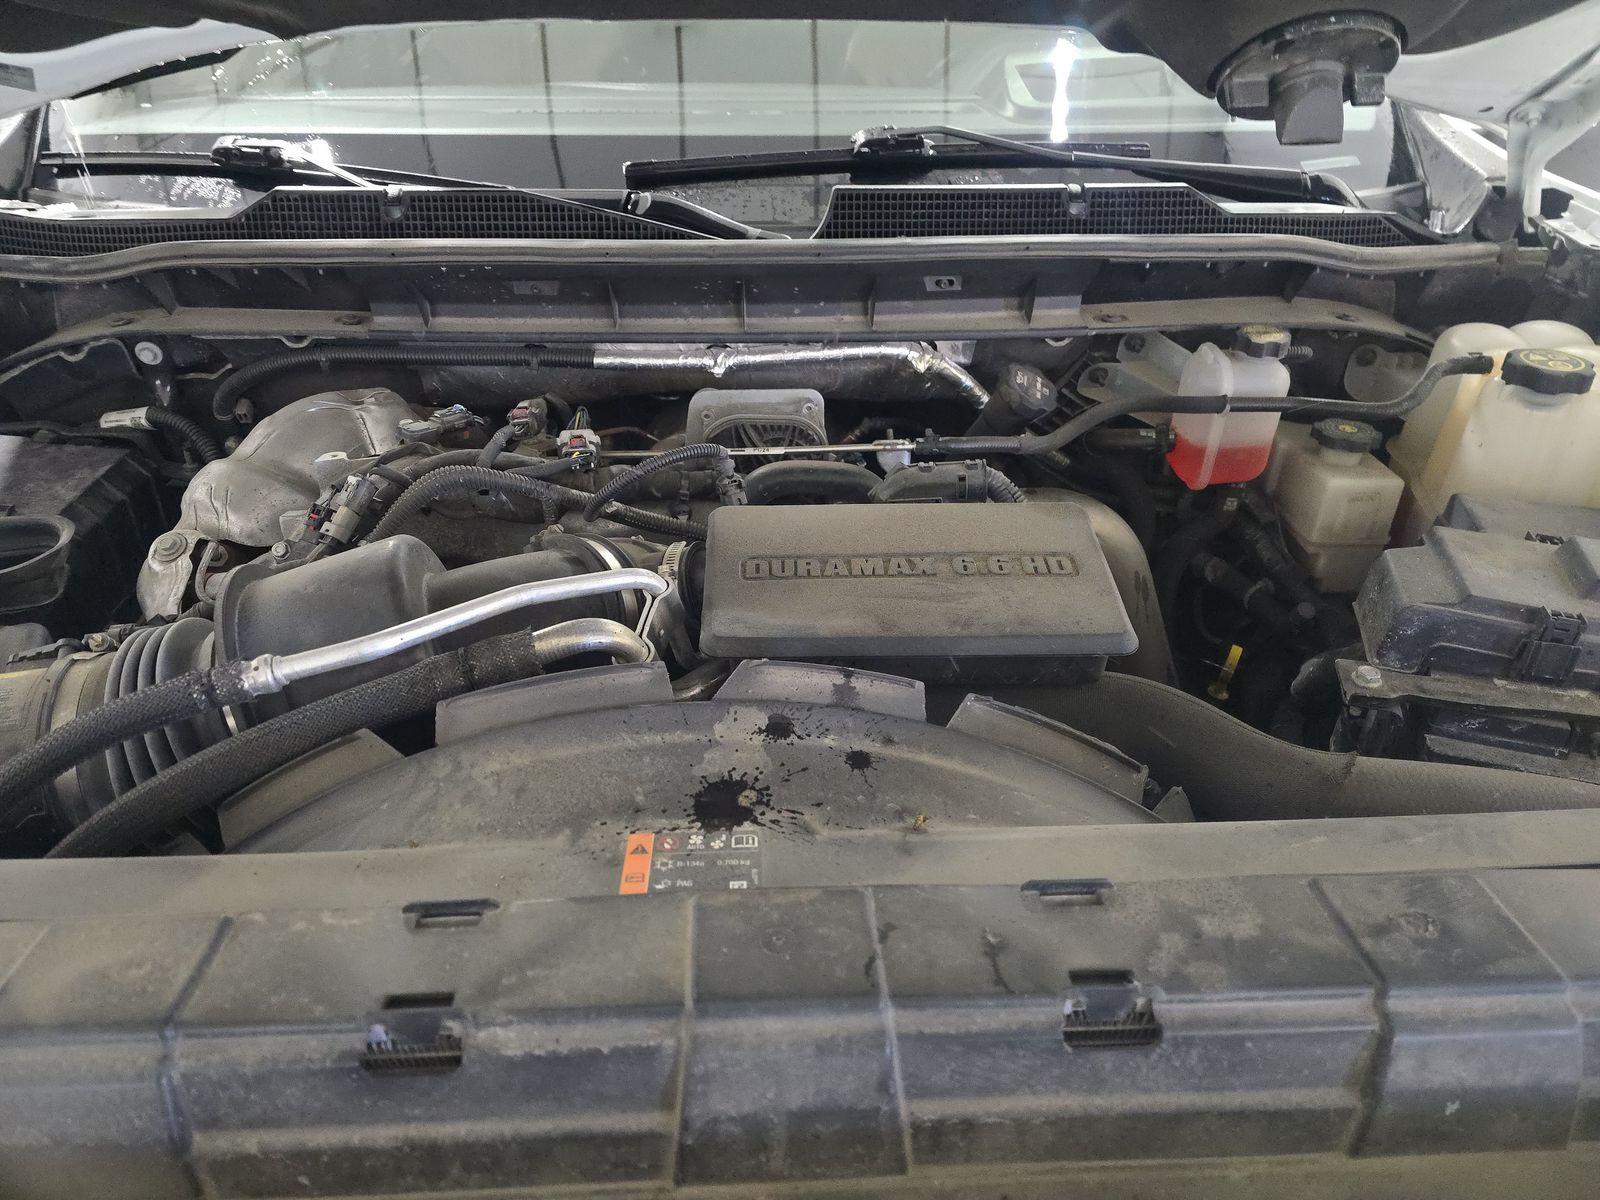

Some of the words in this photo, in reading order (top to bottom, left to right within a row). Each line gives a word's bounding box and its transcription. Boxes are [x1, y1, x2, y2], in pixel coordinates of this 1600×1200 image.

[744, 557, 937, 578] DURAMAX
[952, 556, 1012, 576] 6.6
[1022, 555, 1075, 576] HD
